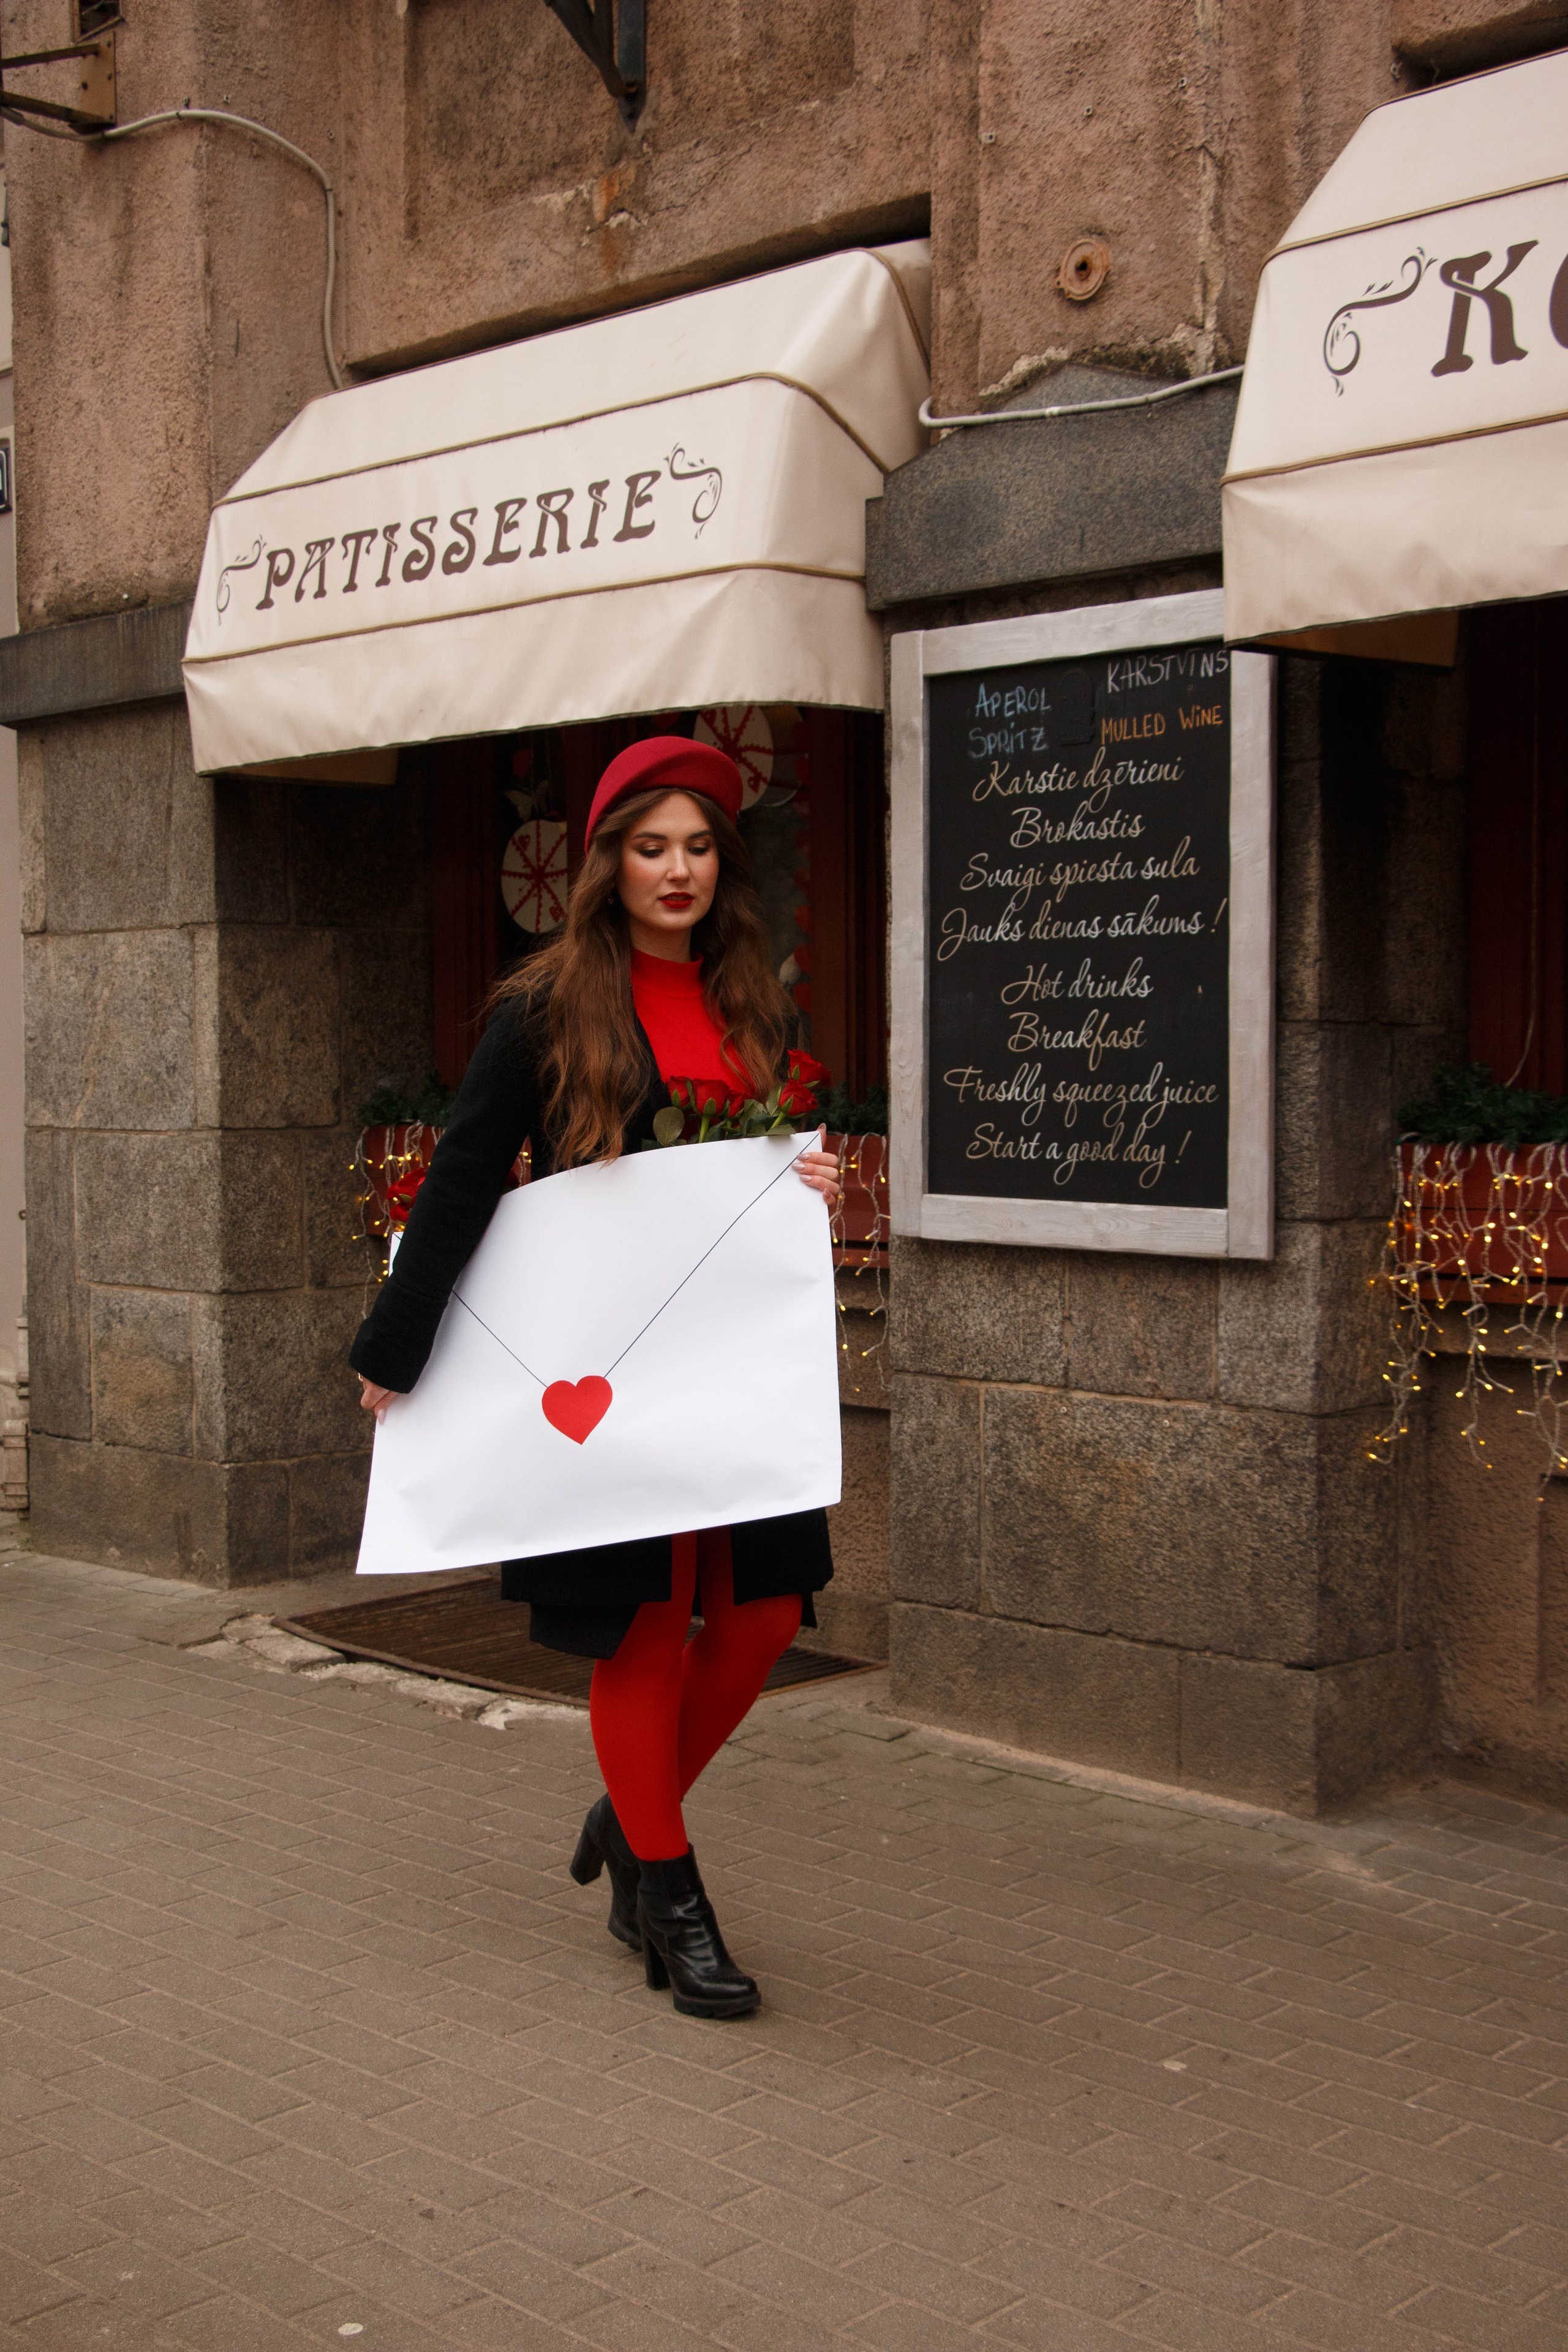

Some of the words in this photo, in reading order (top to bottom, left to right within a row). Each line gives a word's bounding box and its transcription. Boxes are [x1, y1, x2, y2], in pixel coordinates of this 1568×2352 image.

[1431, 240, 1568, 377] K
[255, 469, 663, 610] PATISSERIE
[975, 682, 1052, 717] APEROL
[1101, 712, 1166, 745] MULLED
[972, 760, 1079, 802] Karstie
[1082, 746, 1185, 813] dzērieni
[1010, 800, 1146, 849] Brokastis
[960, 853, 1047, 911] Svaigi
[1049, 852, 1138, 903] spiesta
[1140, 835, 1201, 881] sula
[937, 902, 1026, 961] Jauks
[1029, 900, 1104, 940] dienas
[1000, 962, 1065, 1005] Hot
[1067, 956, 1155, 998] drinks
[1008, 1008, 1148, 1071] Breakfast
[943, 1062, 1047, 1126] Freshly
[1052, 1061, 1164, 1128] squeezed
[1141, 1077, 1219, 1128] juice
[965, 1123, 1043, 1159] Start
[1045, 1141, 1063, 1159] a
[1053, 1122, 1125, 1185] good
